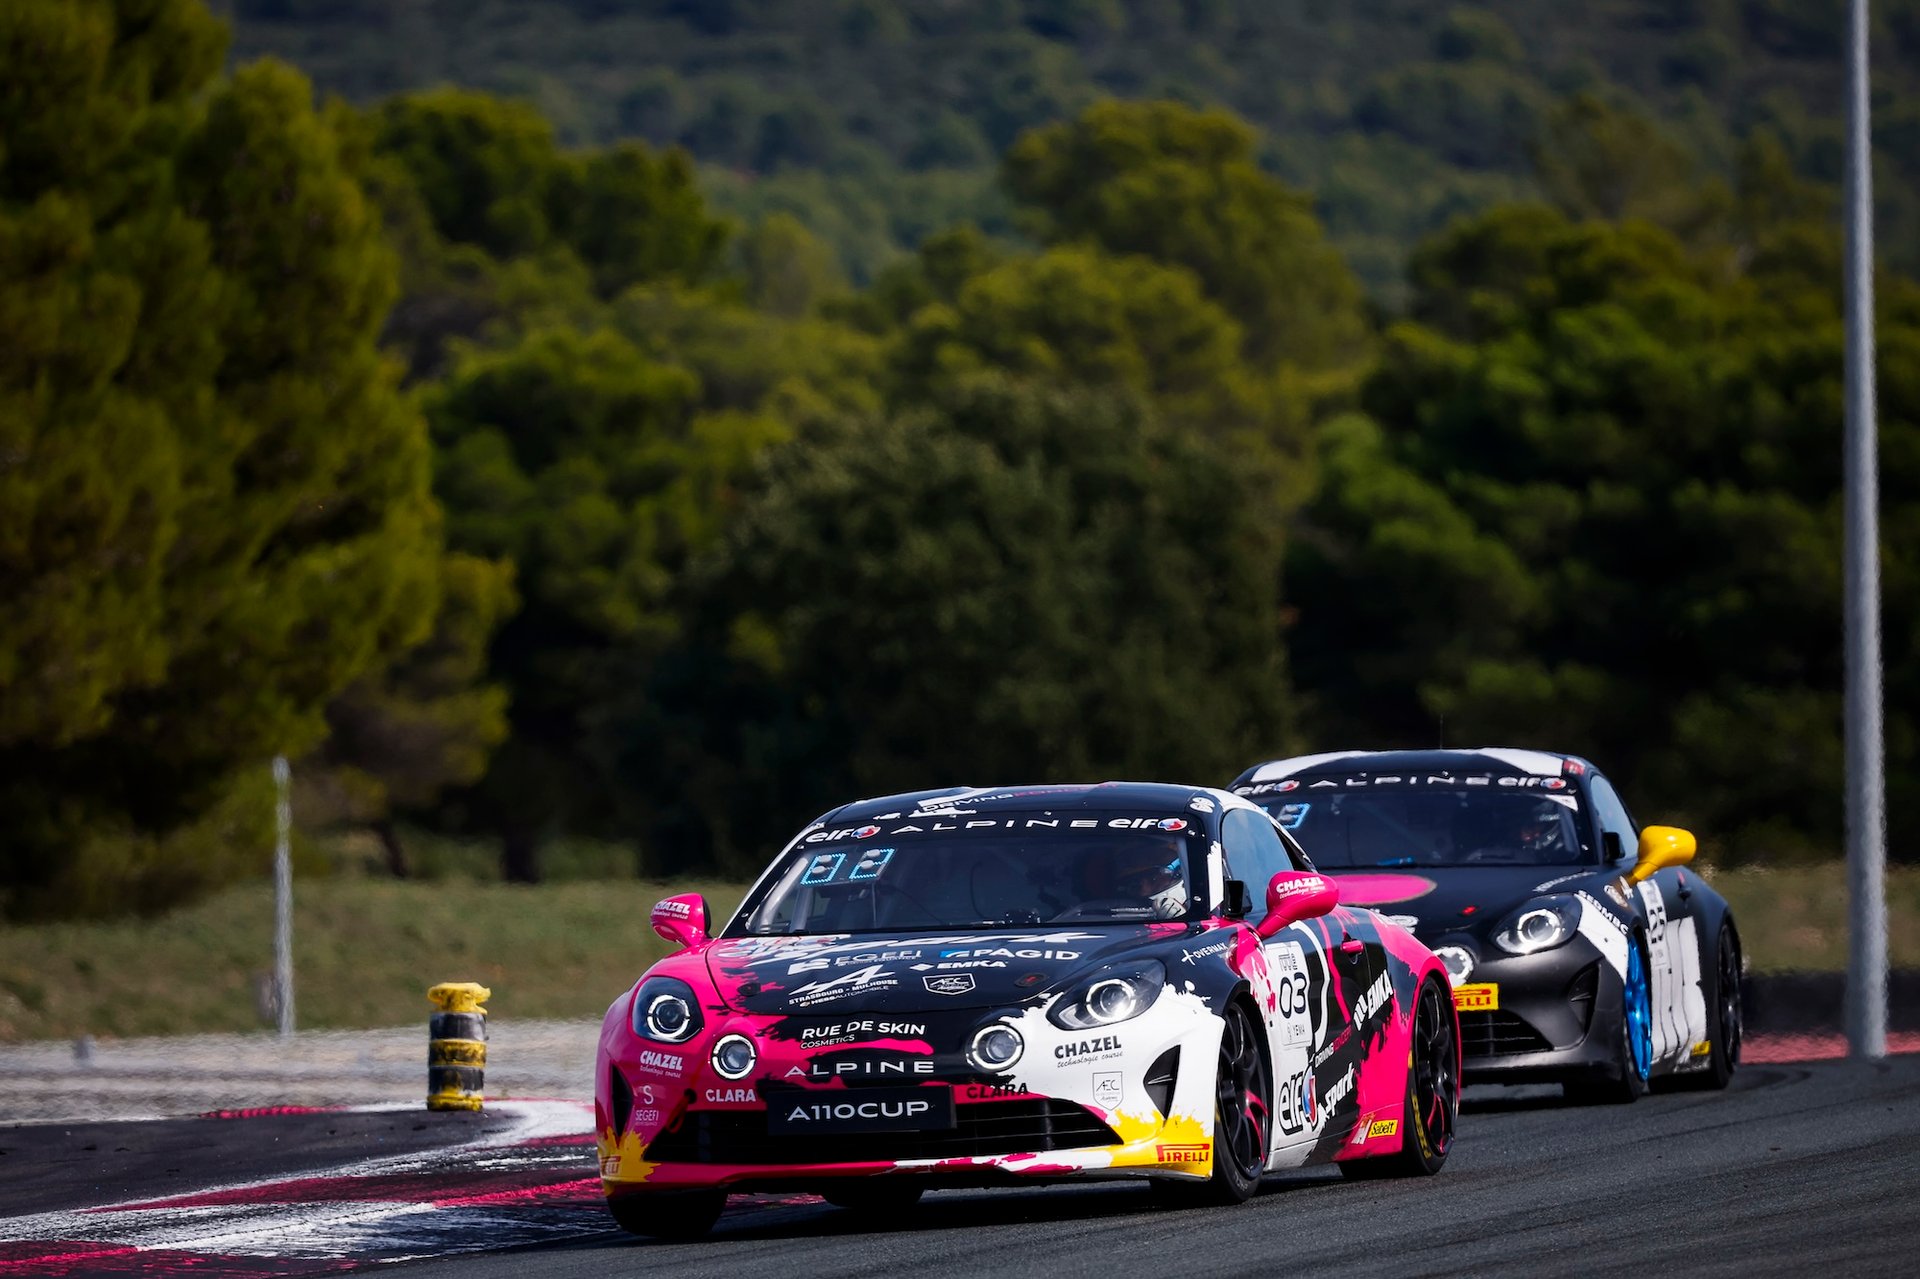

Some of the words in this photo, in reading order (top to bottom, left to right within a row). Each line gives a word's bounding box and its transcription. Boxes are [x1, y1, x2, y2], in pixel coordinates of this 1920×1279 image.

[1308, 775, 1490, 789] ALPINE
[1497, 776, 1541, 787] elf
[890, 819, 1099, 835] ALPINE
[1107, 818, 1159, 829] elf
[805, 828, 854, 843] elf
[1276, 876, 1324, 893] CHAZEL
[973, 948, 1081, 960] PAGID
[1194, 942, 1230, 959] OVERMAX
[937, 960, 1007, 969] EMKA
[851, 979, 898, 991] MULHOUSE
[1280, 972, 1307, 1019] 03
[1366, 969, 1394, 1020] EMKA
[801, 1024, 842, 1040] RUE
[845, 1020, 874, 1033] DE
[877, 1022, 926, 1035] SKIN
[800, 1034, 855, 1049] COSMETICS
[1054, 1035, 1122, 1059] CHAZEL
[640, 1050, 683, 1071] CHAZEL
[1057, 1054, 1099, 1069] technologie
[1101, 1050, 1124, 1060] course
[784, 1061, 934, 1078] ALPINE
[705, 1088, 756, 1103] CLARA
[966, 1082, 1029, 1099] CLARA
[1324, 1062, 1355, 1117] spark
[787, 1101, 929, 1121] A110CUP
[1279, 1071, 1304, 1135] elf
[635, 1109, 659, 1122] SEGEFI
[1156, 1143, 1210, 1163] PIRELLI
